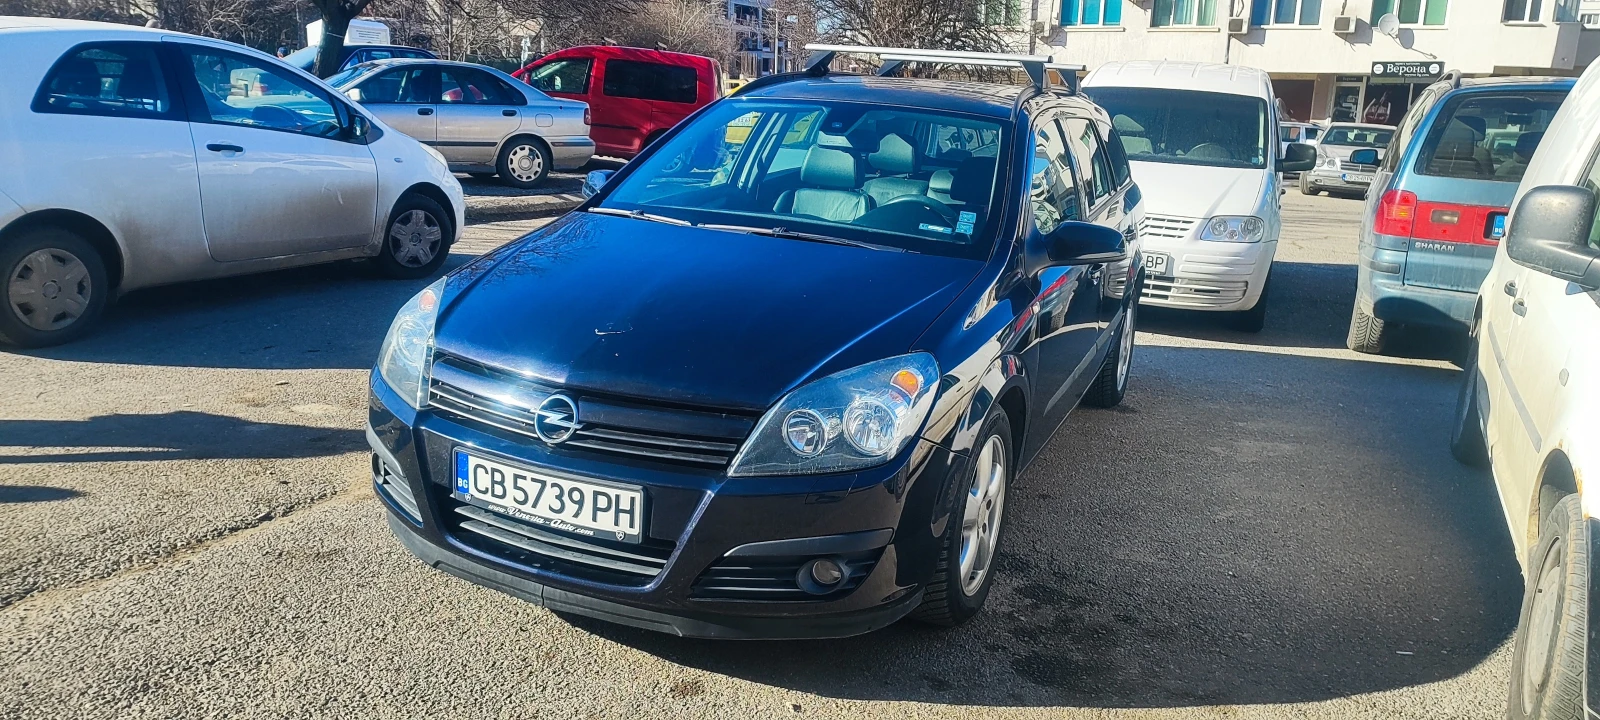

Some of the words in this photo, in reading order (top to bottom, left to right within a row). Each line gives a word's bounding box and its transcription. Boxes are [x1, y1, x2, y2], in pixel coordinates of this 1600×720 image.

[1387, 63, 1426, 75] Верона
[1415, 241, 1455, 251] SHARAN
[457, 477, 468, 489] BG
